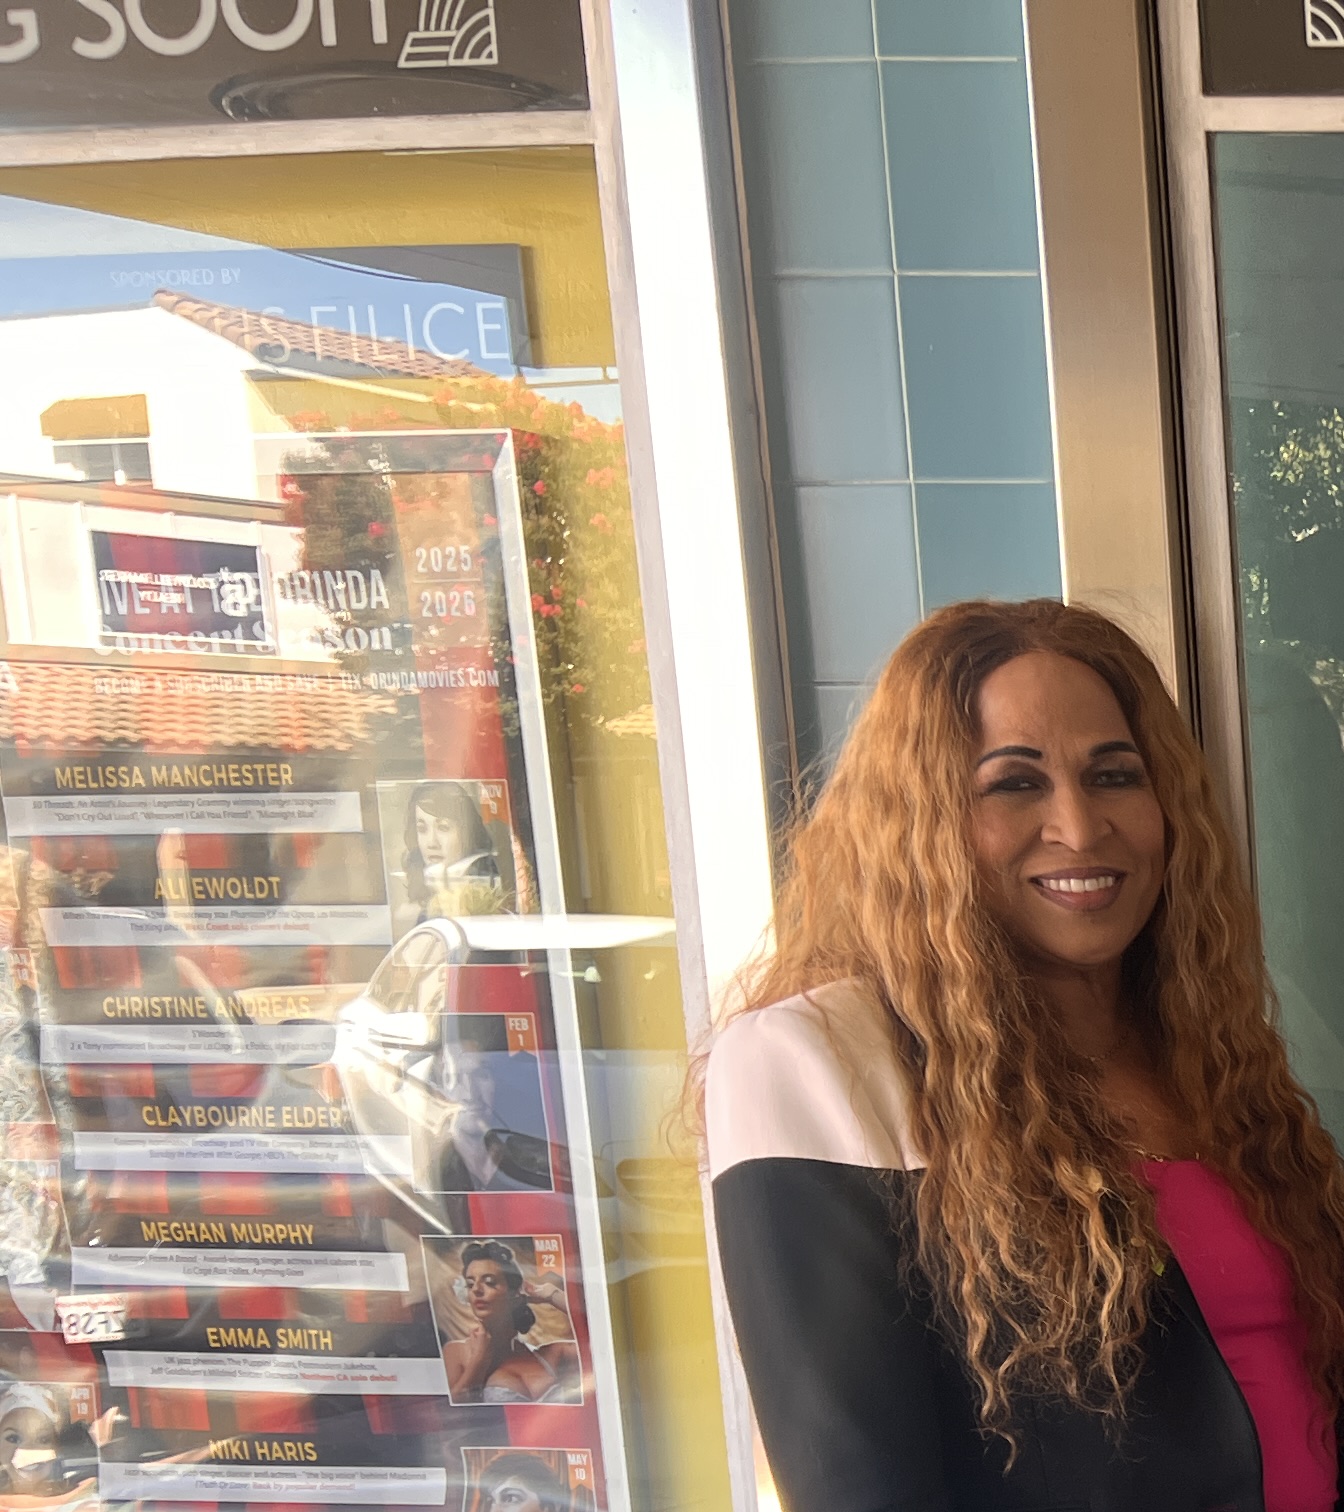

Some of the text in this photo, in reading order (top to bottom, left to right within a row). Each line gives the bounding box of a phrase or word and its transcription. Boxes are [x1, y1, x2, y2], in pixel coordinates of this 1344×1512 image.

[110, 266, 241, 288] SPONSORED BY
[310, 301, 512, 362] FILICE
[415, 545, 472, 573] 2025
[420, 590, 476, 617] 2026
[54, 763, 294, 789] MELISSA MANCHESTER
[155, 876, 281, 900] ALI EWOLDT
[102, 996, 311, 1018] CHRISTINE ANDREAS
[508, 1017, 529, 1031] FEB
[142, 1104, 342, 1128] CLAYBOURNE ELDER
[140, 1221, 314, 1246] MEGHAN MURPHY
[206, 1327, 333, 1350] EMMA SMITH
[209, 1439, 318, 1462] NIKI HARIS
